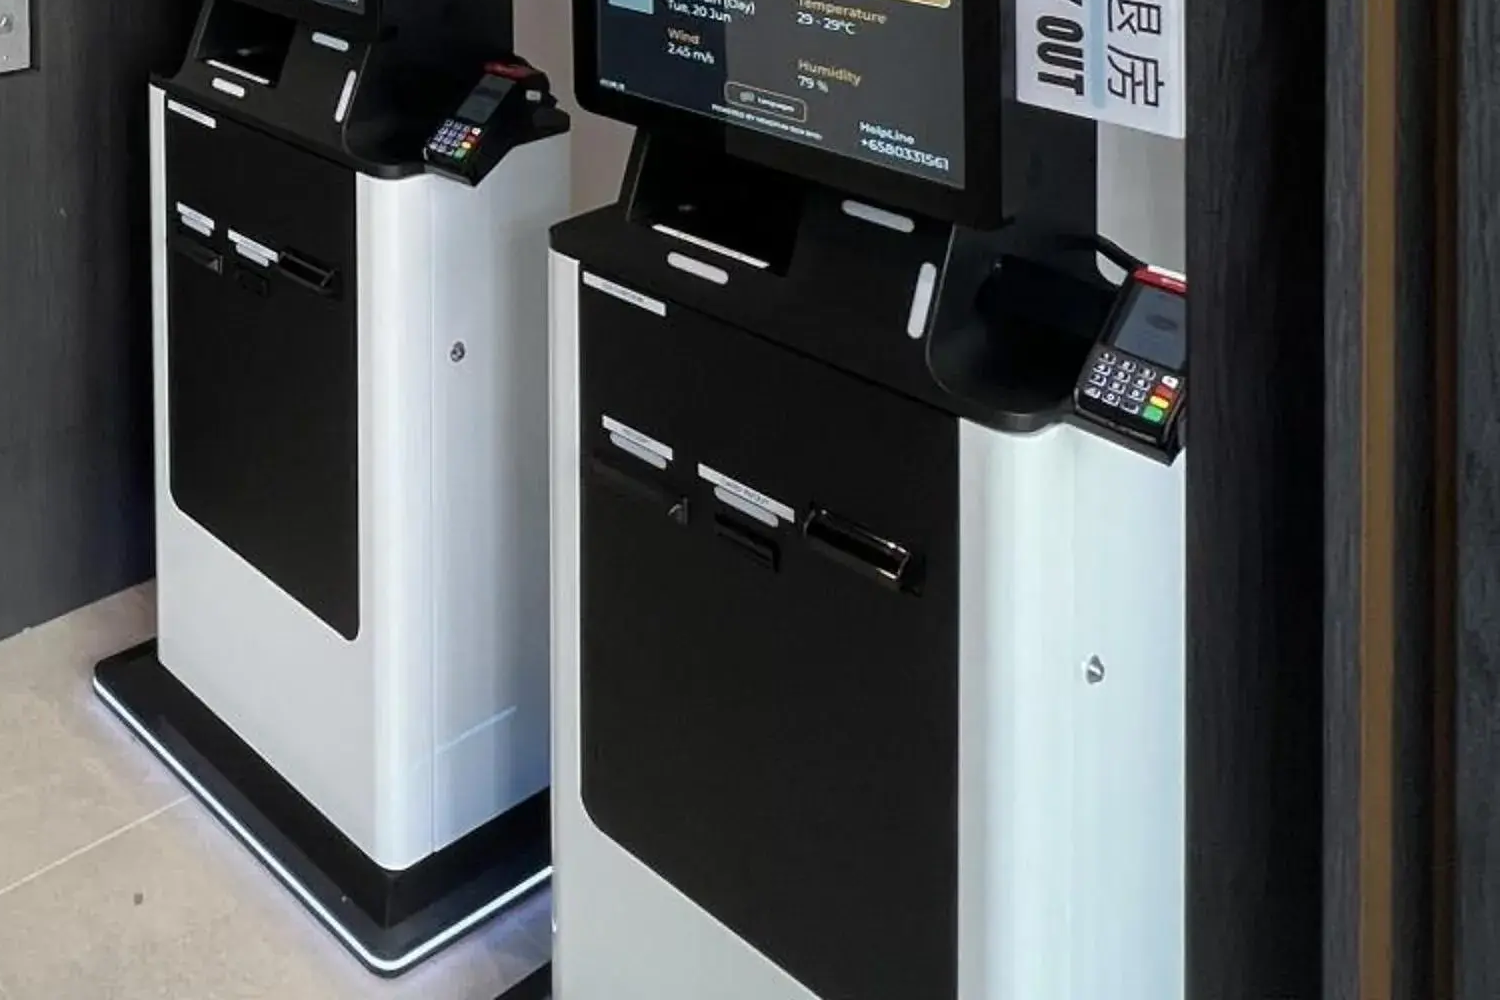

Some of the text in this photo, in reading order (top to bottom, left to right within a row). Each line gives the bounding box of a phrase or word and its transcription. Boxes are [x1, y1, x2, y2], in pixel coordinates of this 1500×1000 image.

[691, 3, 707, 18] 20
[709, 7, 732, 23] Jun
[667, 26, 700, 45] Wind
[1036, 15, 1084, 96] OUT
[797, 75, 814, 89] 79
[798, 59, 862, 87] Humidity
